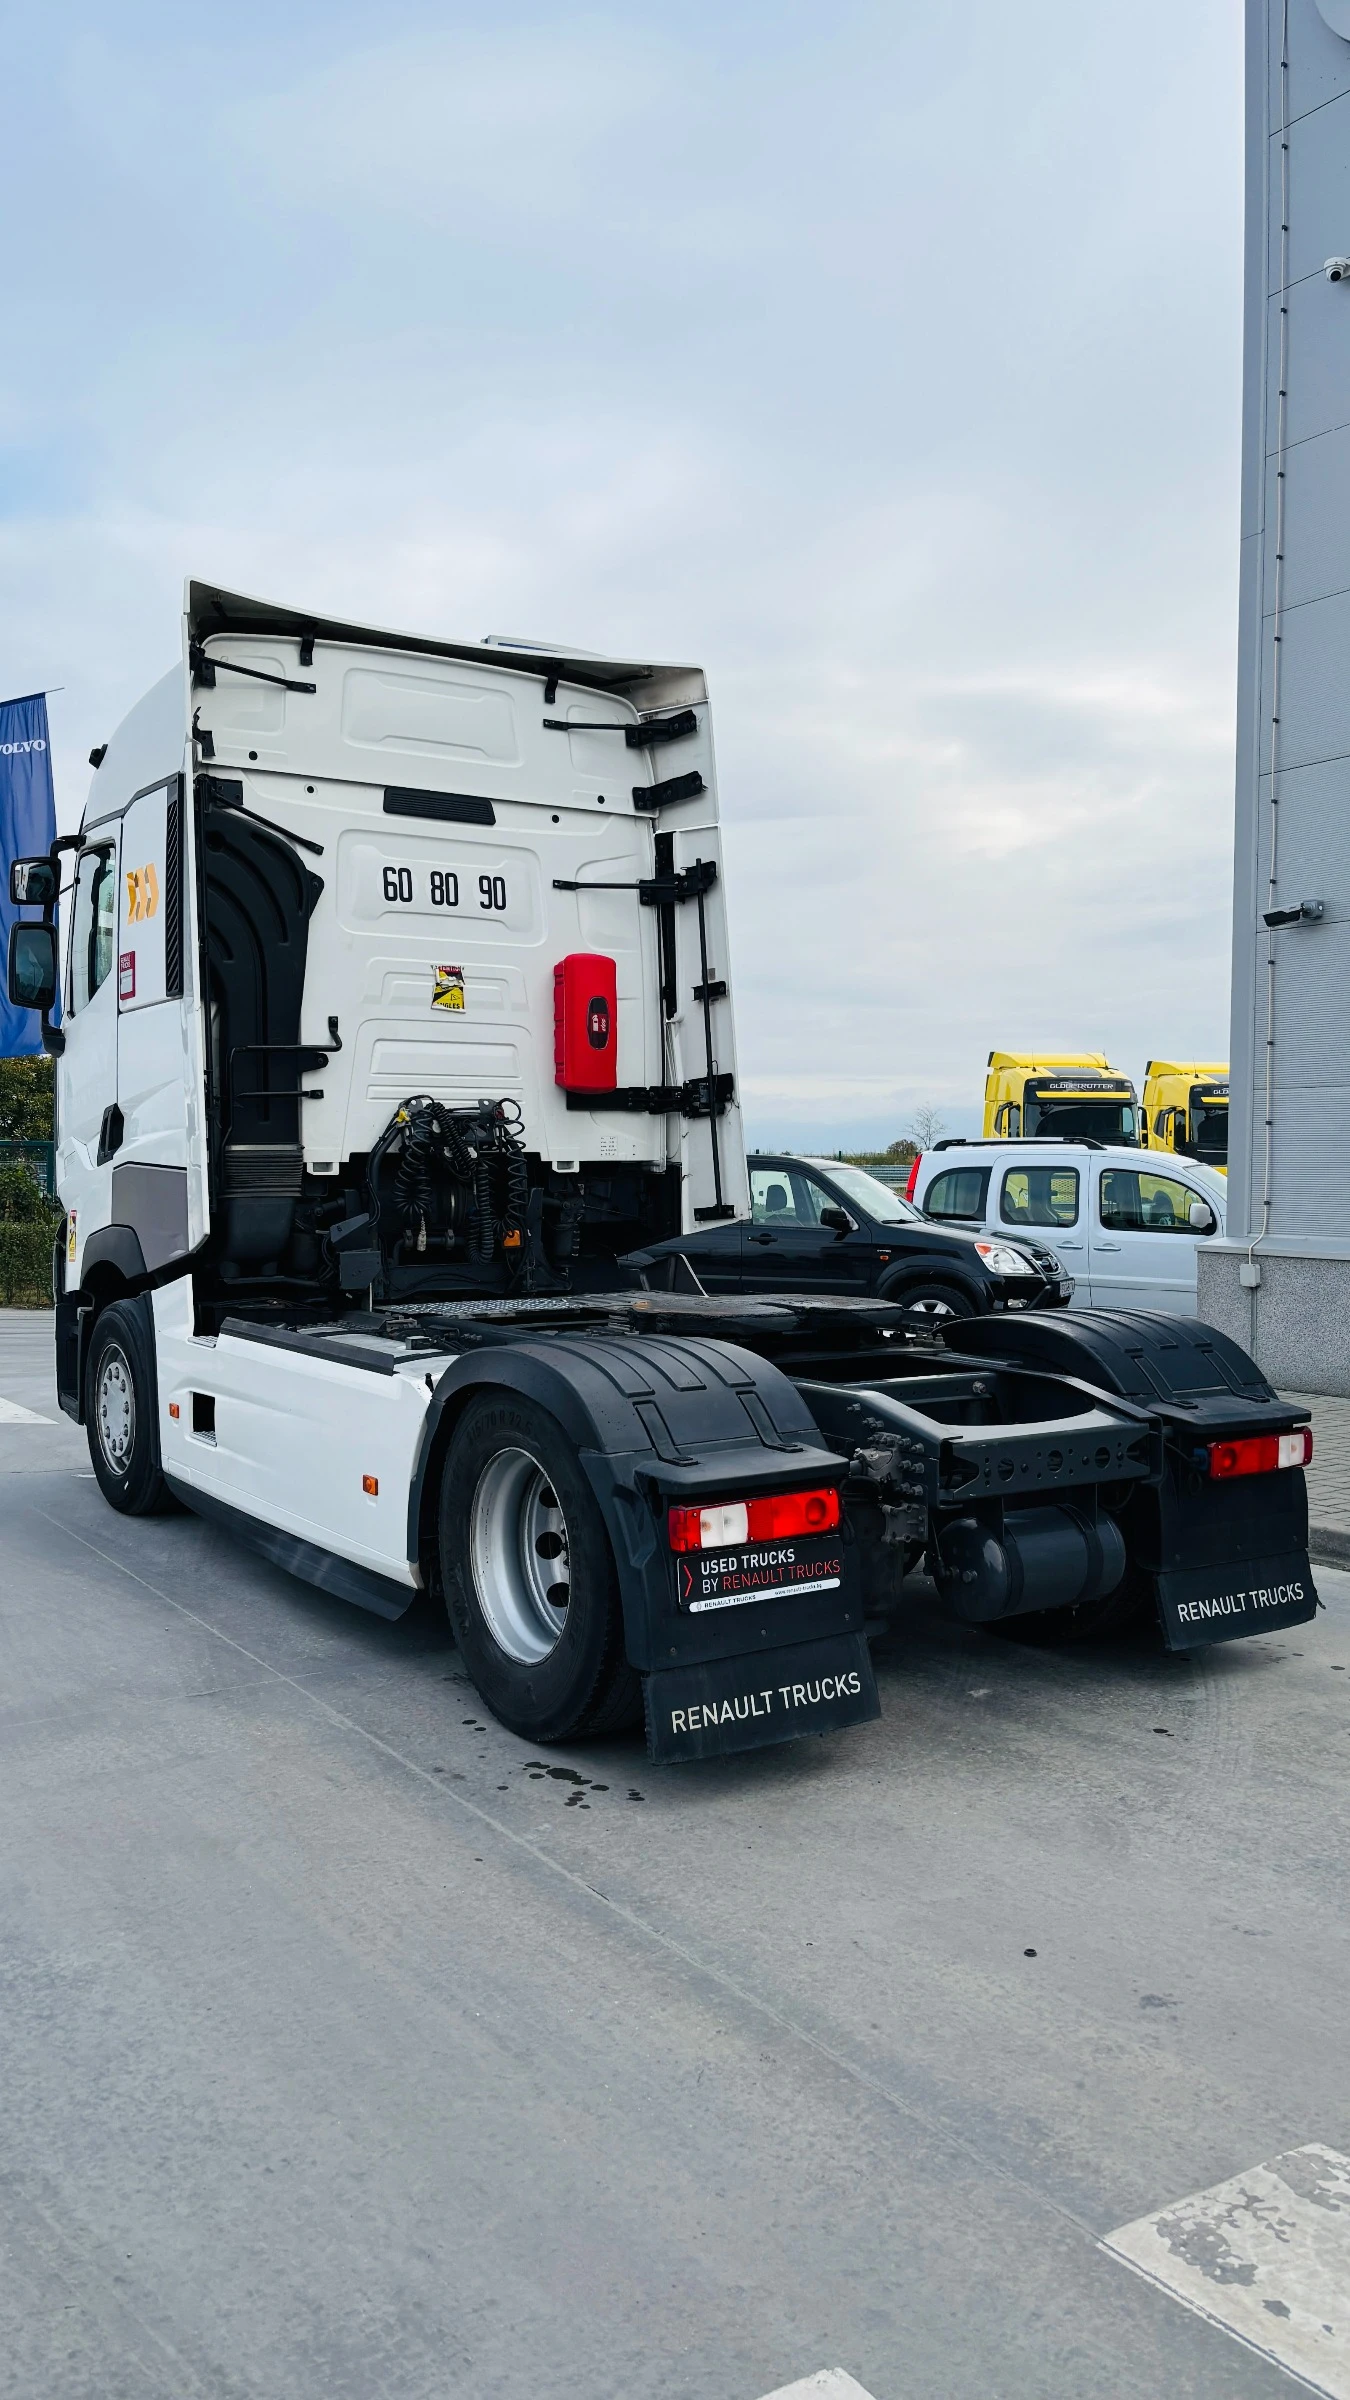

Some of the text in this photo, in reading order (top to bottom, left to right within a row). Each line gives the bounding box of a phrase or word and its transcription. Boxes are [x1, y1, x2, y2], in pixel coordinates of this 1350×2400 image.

[382, 866, 507, 910] 60 80 90
[701, 1548, 796, 1575] USED TRUCKS
[702, 1559, 841, 1594] BY RENAULT TRUCKS
[704, 1599, 732, 1608] RENAULT
[733, 1594, 756, 1604] TRUCKS
[1177, 1582, 1304, 1623] RENAULT TRUCKS
[671, 1671, 861, 1734] RENAULT TRUCKS
